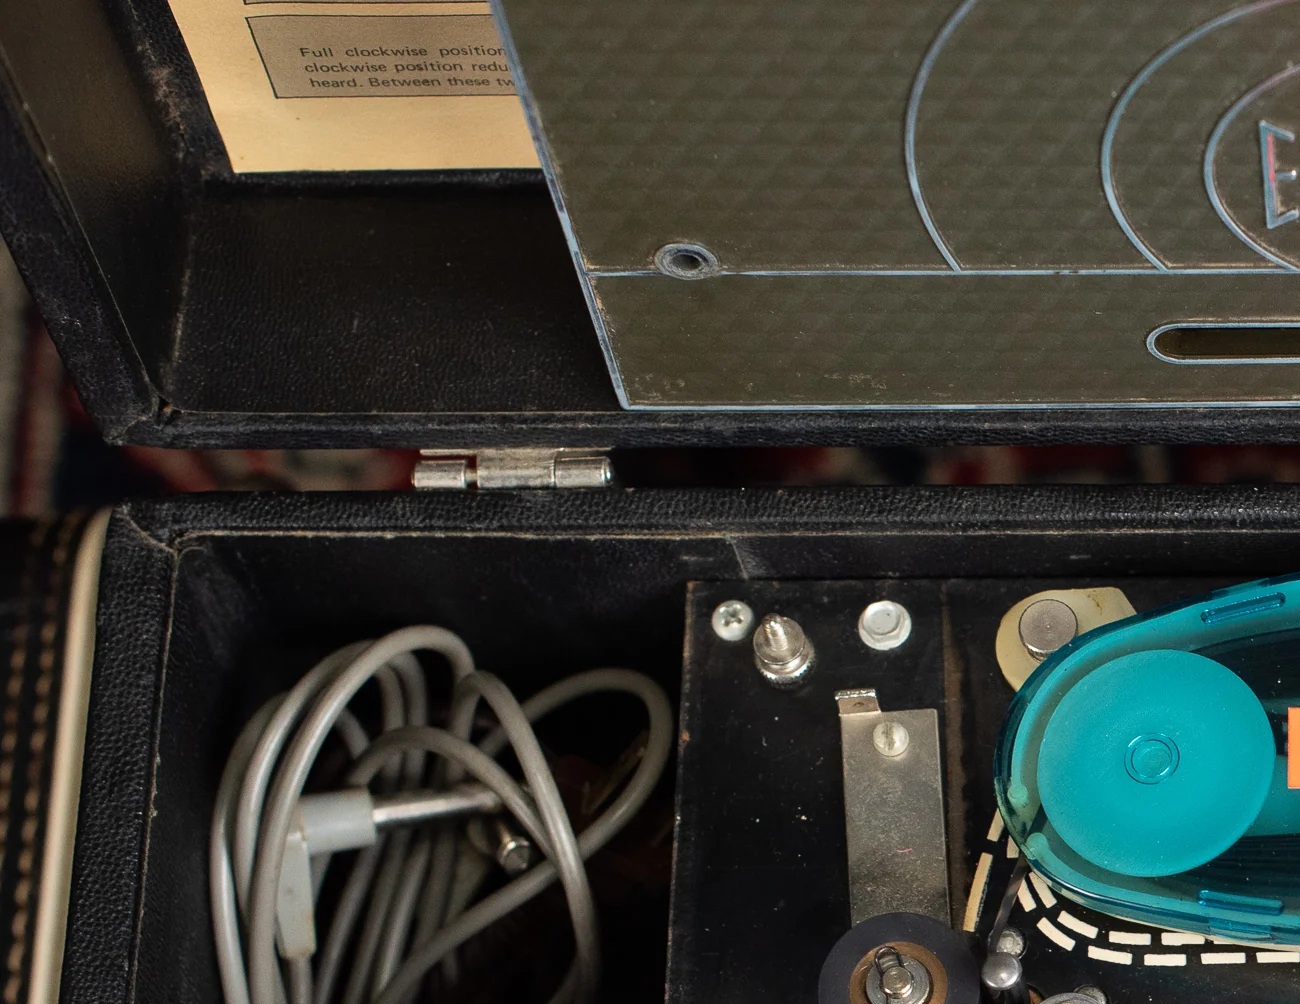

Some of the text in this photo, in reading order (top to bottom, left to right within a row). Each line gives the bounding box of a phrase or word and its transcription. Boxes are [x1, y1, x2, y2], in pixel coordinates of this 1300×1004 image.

[300, 47, 333, 58] Full
[345, 46, 428, 58] clockwise
[304, 61, 511, 77] clockwise position redu
[310, 76, 362, 89] heard.
[369, 76, 440, 88] Between
[447, 76, 491, 88] these
